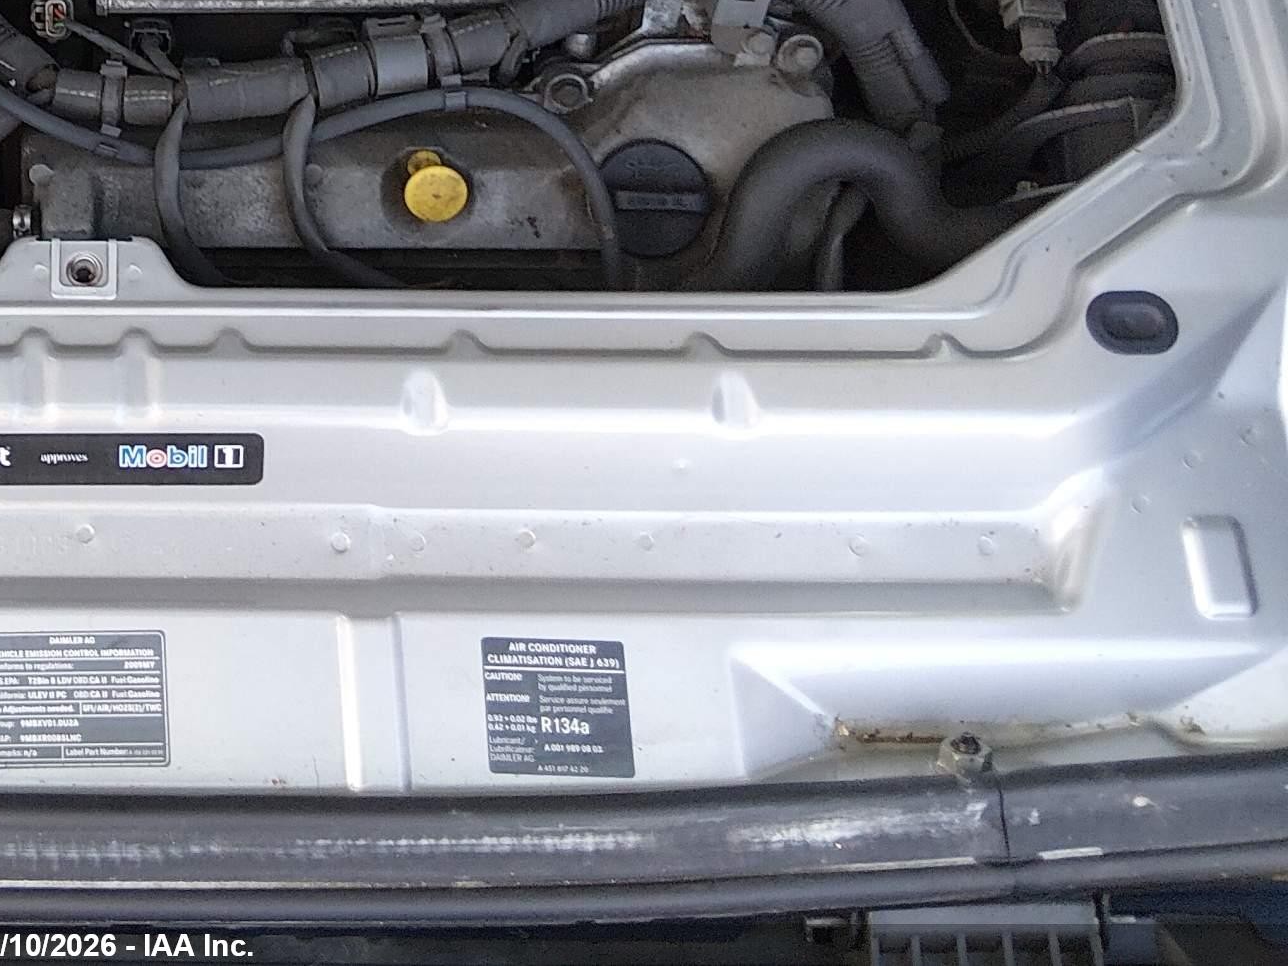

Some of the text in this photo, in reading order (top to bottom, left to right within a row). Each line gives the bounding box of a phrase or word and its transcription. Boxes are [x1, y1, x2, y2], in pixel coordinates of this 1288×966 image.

[118, 444, 208, 468] Mobil
[50, 636, 84, 645] DAIMLER
[25, 650, 62, 658] EMISSION
[63, 649, 99, 657] CONTROL
[101, 649, 154, 657] INFORMATION
[509, 642, 596, 654] AIR CONDITIONER
[488, 654, 562, 666] CLIMATISATION
[565, 656, 587, 667] (SAE
[596, 658, 619, 668] 639)
